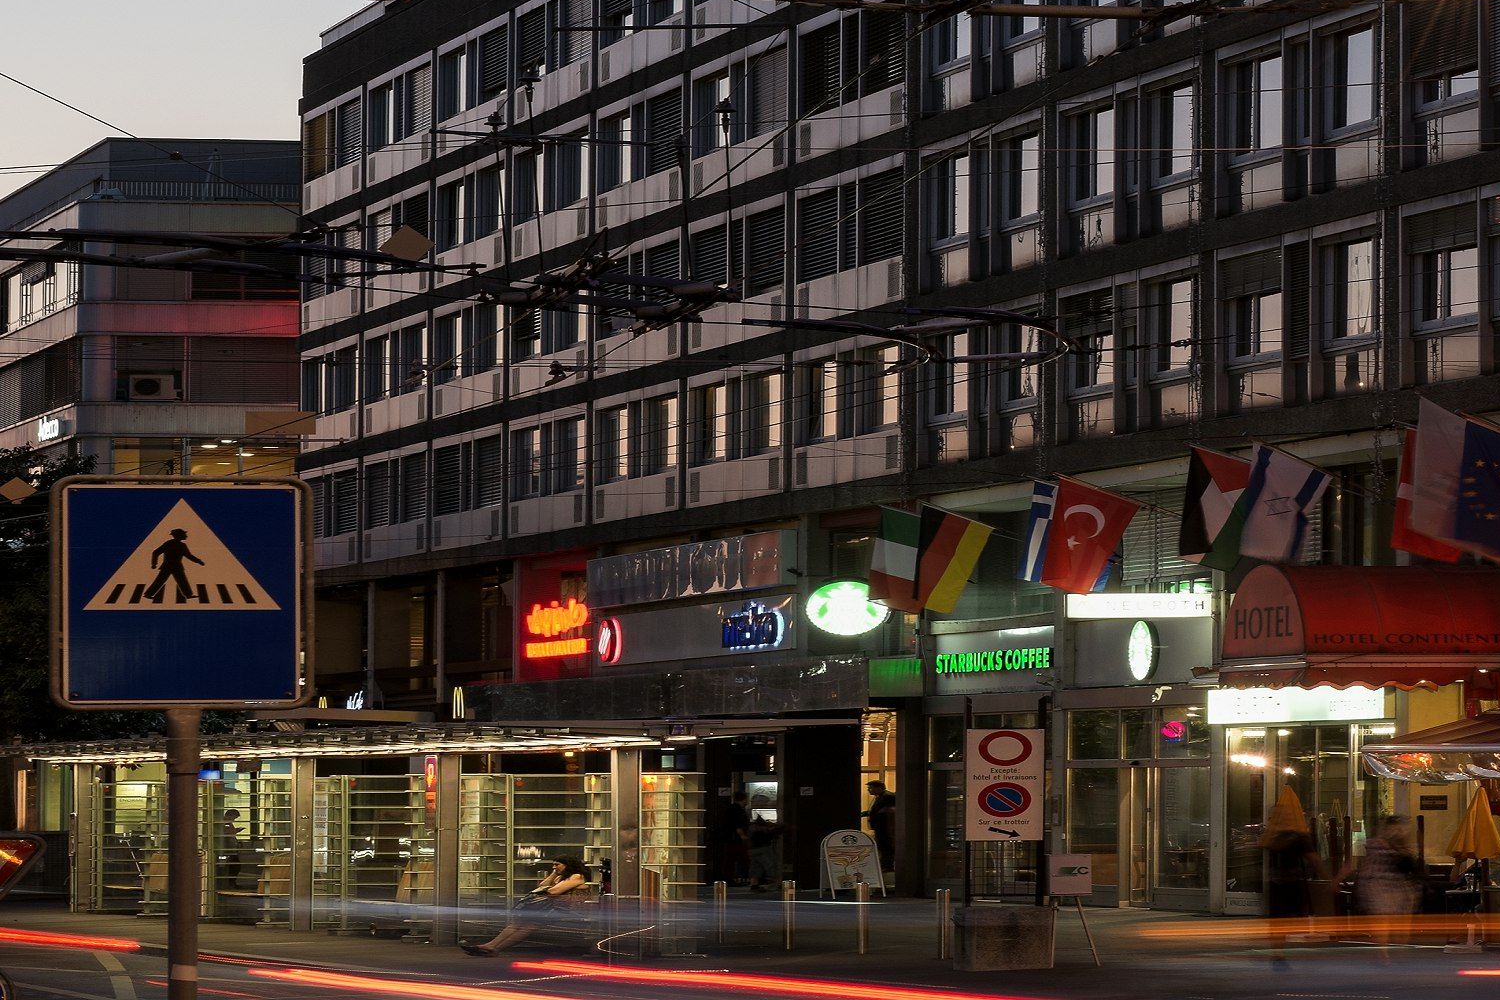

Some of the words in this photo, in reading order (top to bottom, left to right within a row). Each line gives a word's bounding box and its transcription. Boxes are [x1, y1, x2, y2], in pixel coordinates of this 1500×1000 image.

[1233, 605, 1294, 640] HOTEL
[1314, 633, 1380, 644] HOTEL
[936, 649, 1003, 674] STARBUCKS
[1005, 647, 1050, 670] COFFEE
